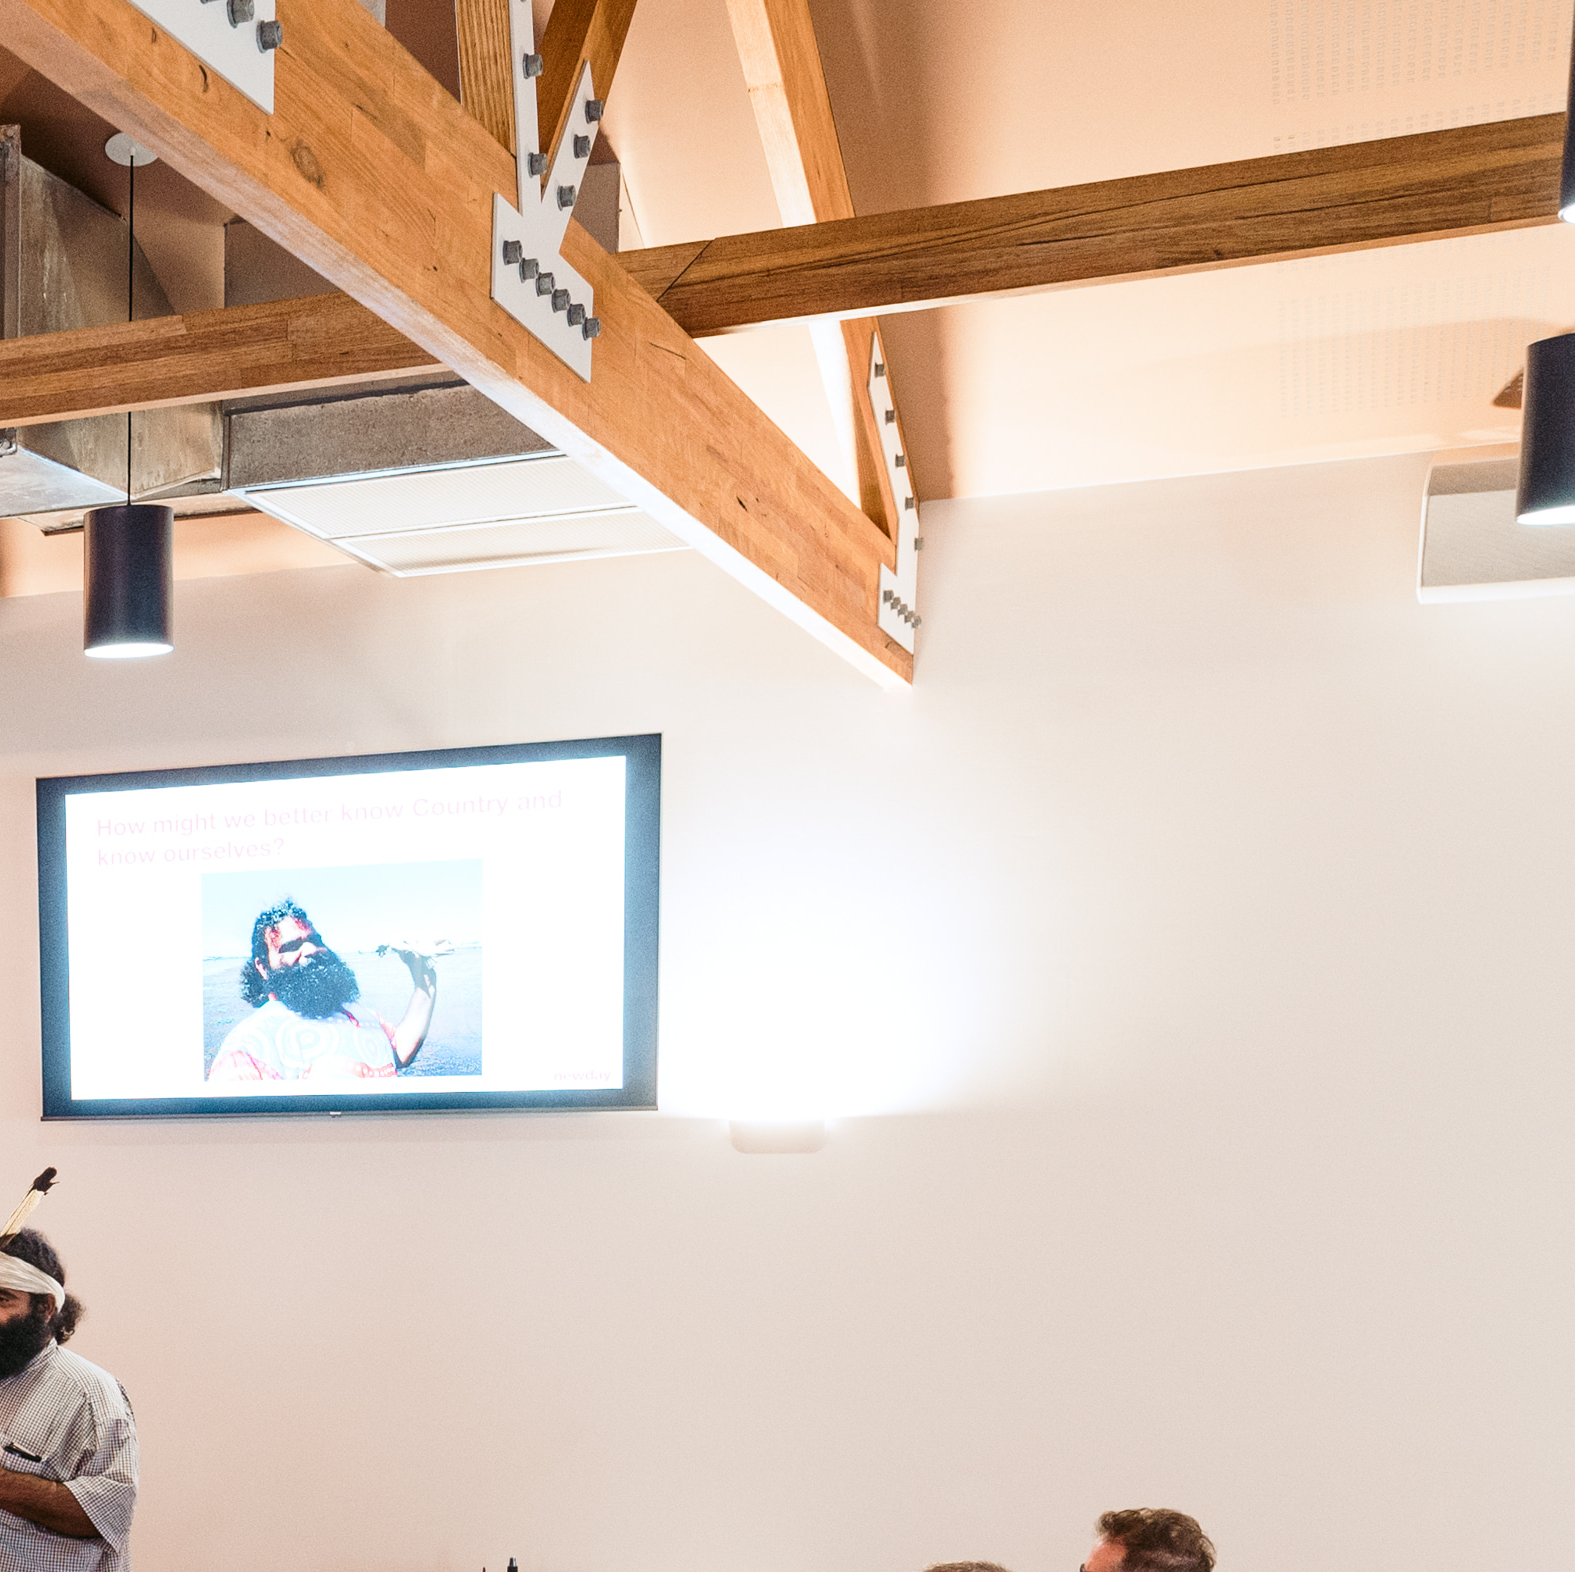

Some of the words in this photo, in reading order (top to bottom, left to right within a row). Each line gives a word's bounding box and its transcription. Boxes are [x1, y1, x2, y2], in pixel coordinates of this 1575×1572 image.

[97, 819, 145, 837] How
[153, 813, 217, 836] might
[224, 814, 256, 829] we
[264, 807, 330, 827] better
[341, 804, 404, 821] know
[412, 796, 509, 817] Country
[517, 790, 562, 811] and
[98, 849, 156, 866] know
[163, 838, 285, 863] ourselves?
